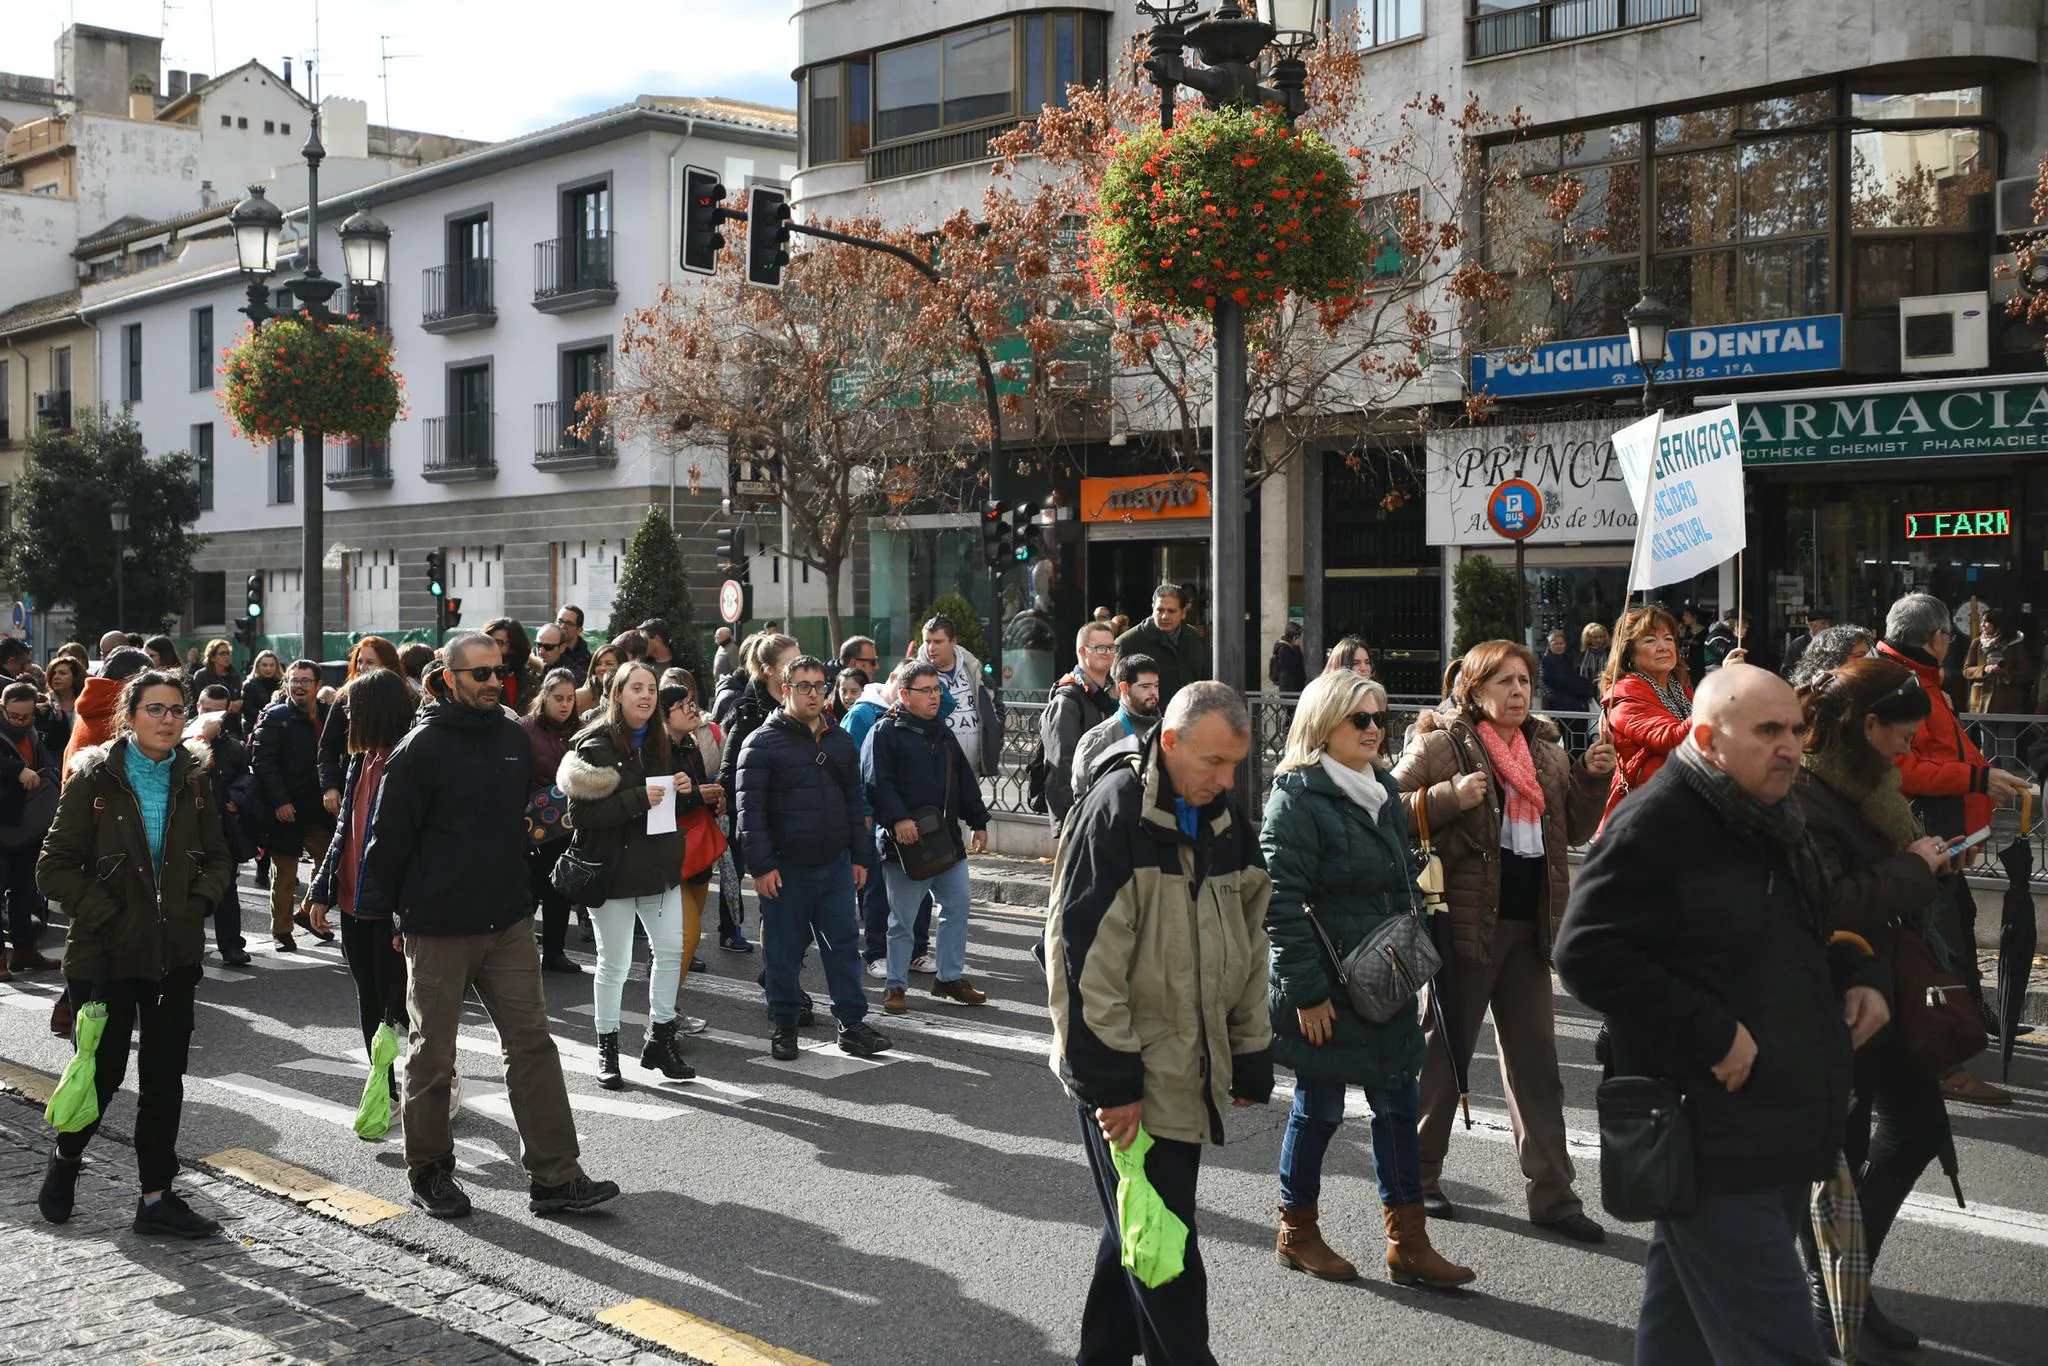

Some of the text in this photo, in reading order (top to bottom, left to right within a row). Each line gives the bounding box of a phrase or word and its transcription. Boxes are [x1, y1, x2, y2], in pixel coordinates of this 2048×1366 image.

[1690, 325, 1824, 360] DENTAL
[1655, 366, 1705, 381] 23128
[1740, 385, 2048, 443] ARMACIA
[1830, 441, 1908, 454] CHEMIST
[1505, 512, 1524, 521] BUS
[1566, 507, 1587, 528] de
